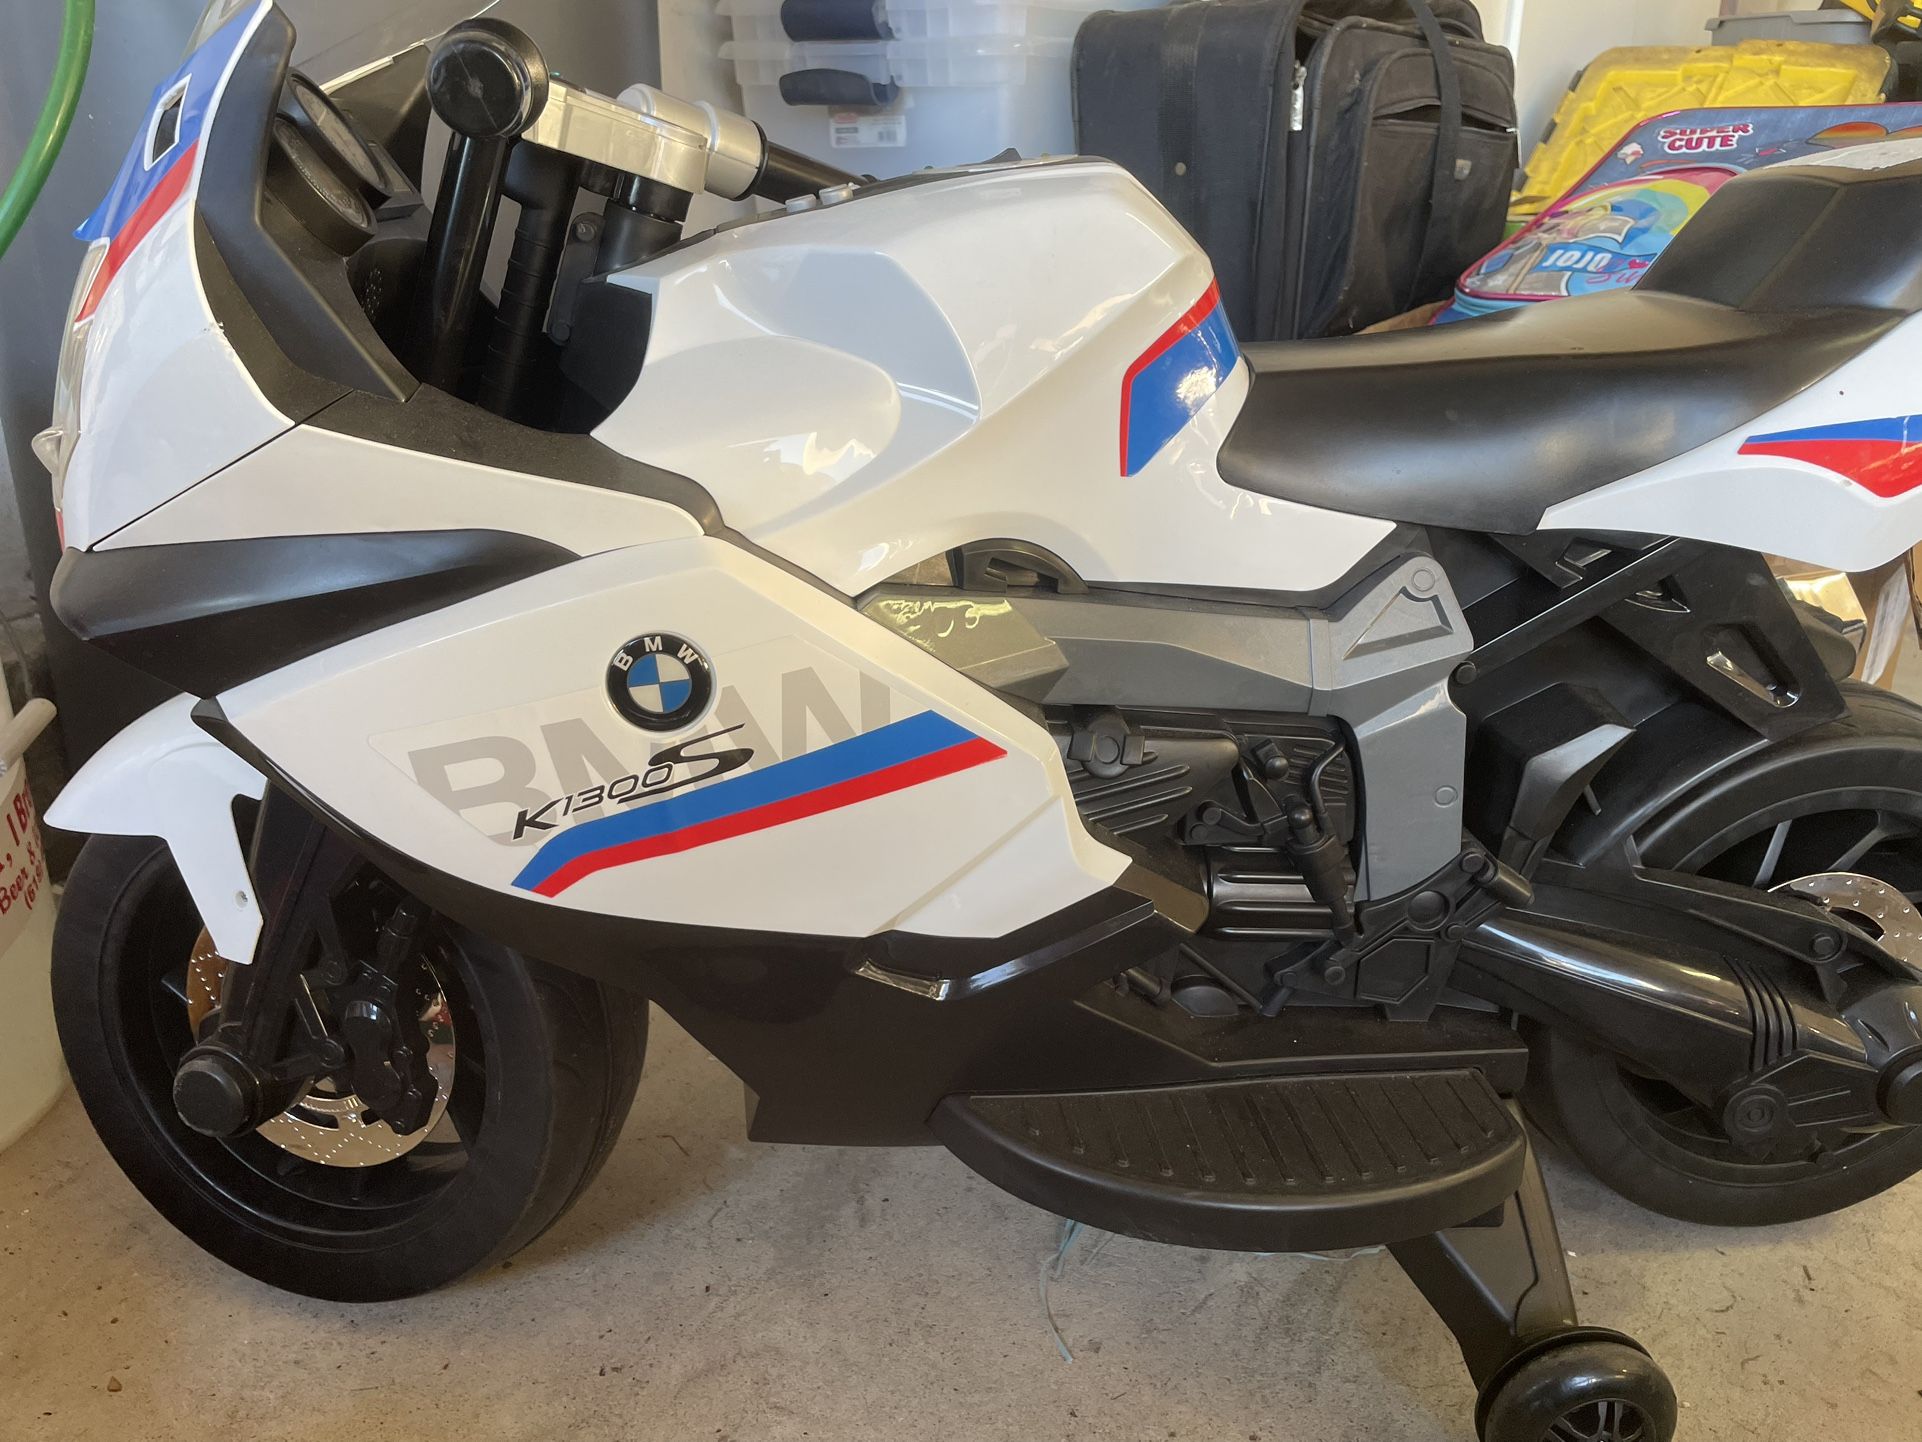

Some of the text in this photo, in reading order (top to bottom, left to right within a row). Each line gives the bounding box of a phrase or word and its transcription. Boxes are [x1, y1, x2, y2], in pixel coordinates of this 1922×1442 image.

[1666, 134, 1736, 152] CUTE
[1541, 249, 1612, 273] JOJO
[612, 636, 700, 671] BMW
